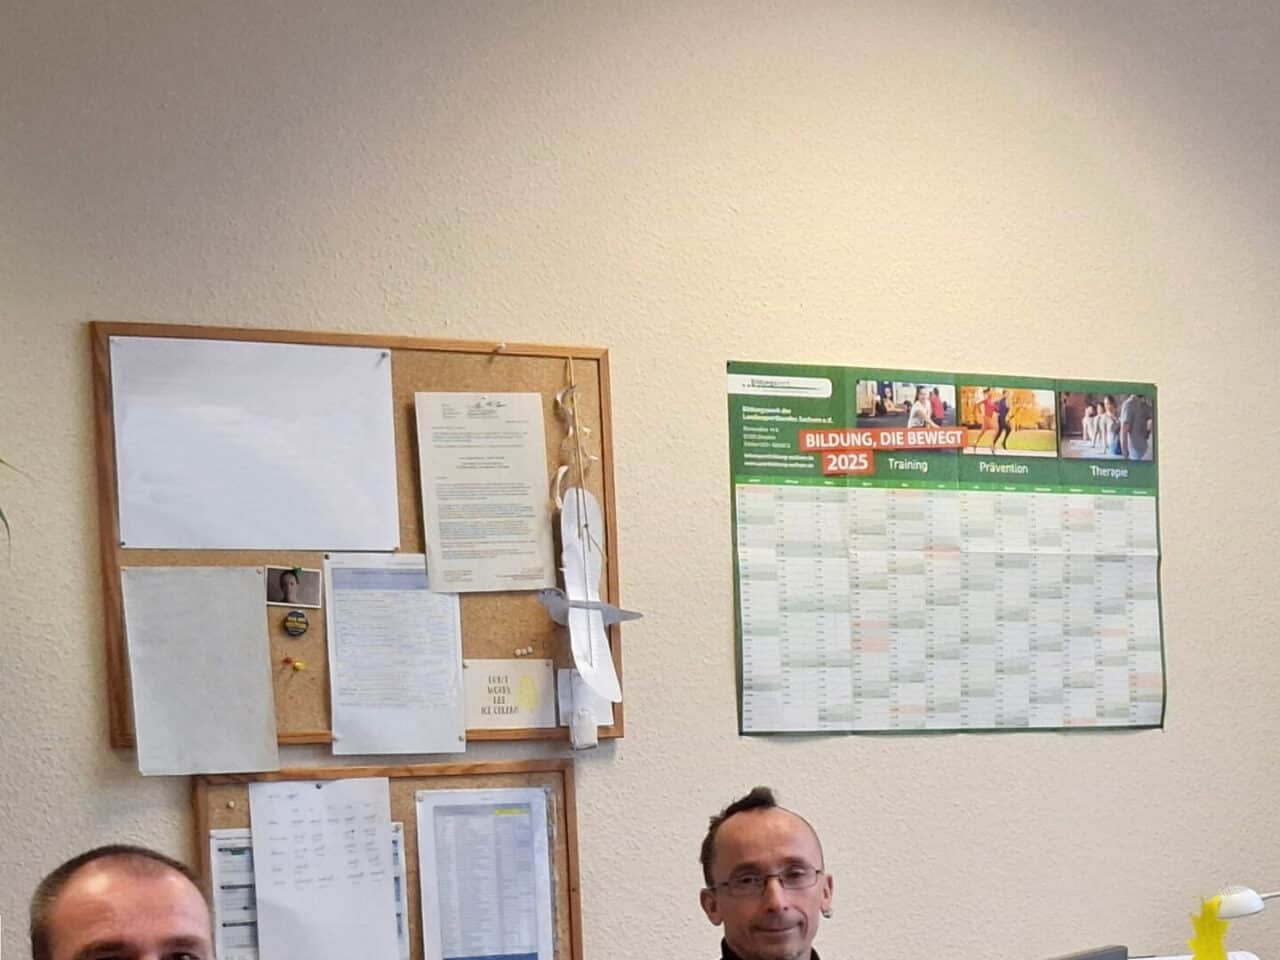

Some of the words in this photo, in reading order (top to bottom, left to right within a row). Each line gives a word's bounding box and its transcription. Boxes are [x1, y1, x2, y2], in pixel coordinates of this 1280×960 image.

[805, 432, 877, 448] BILDUNG,
[880, 431, 904, 446] DIE
[907, 430, 963, 445] BEWEGT
[827, 453, 869, 472] 2025
[888, 457, 929, 473] Training
[979, 461, 1029, 474] Prävention
[1090, 464, 1129, 478] Therapie
